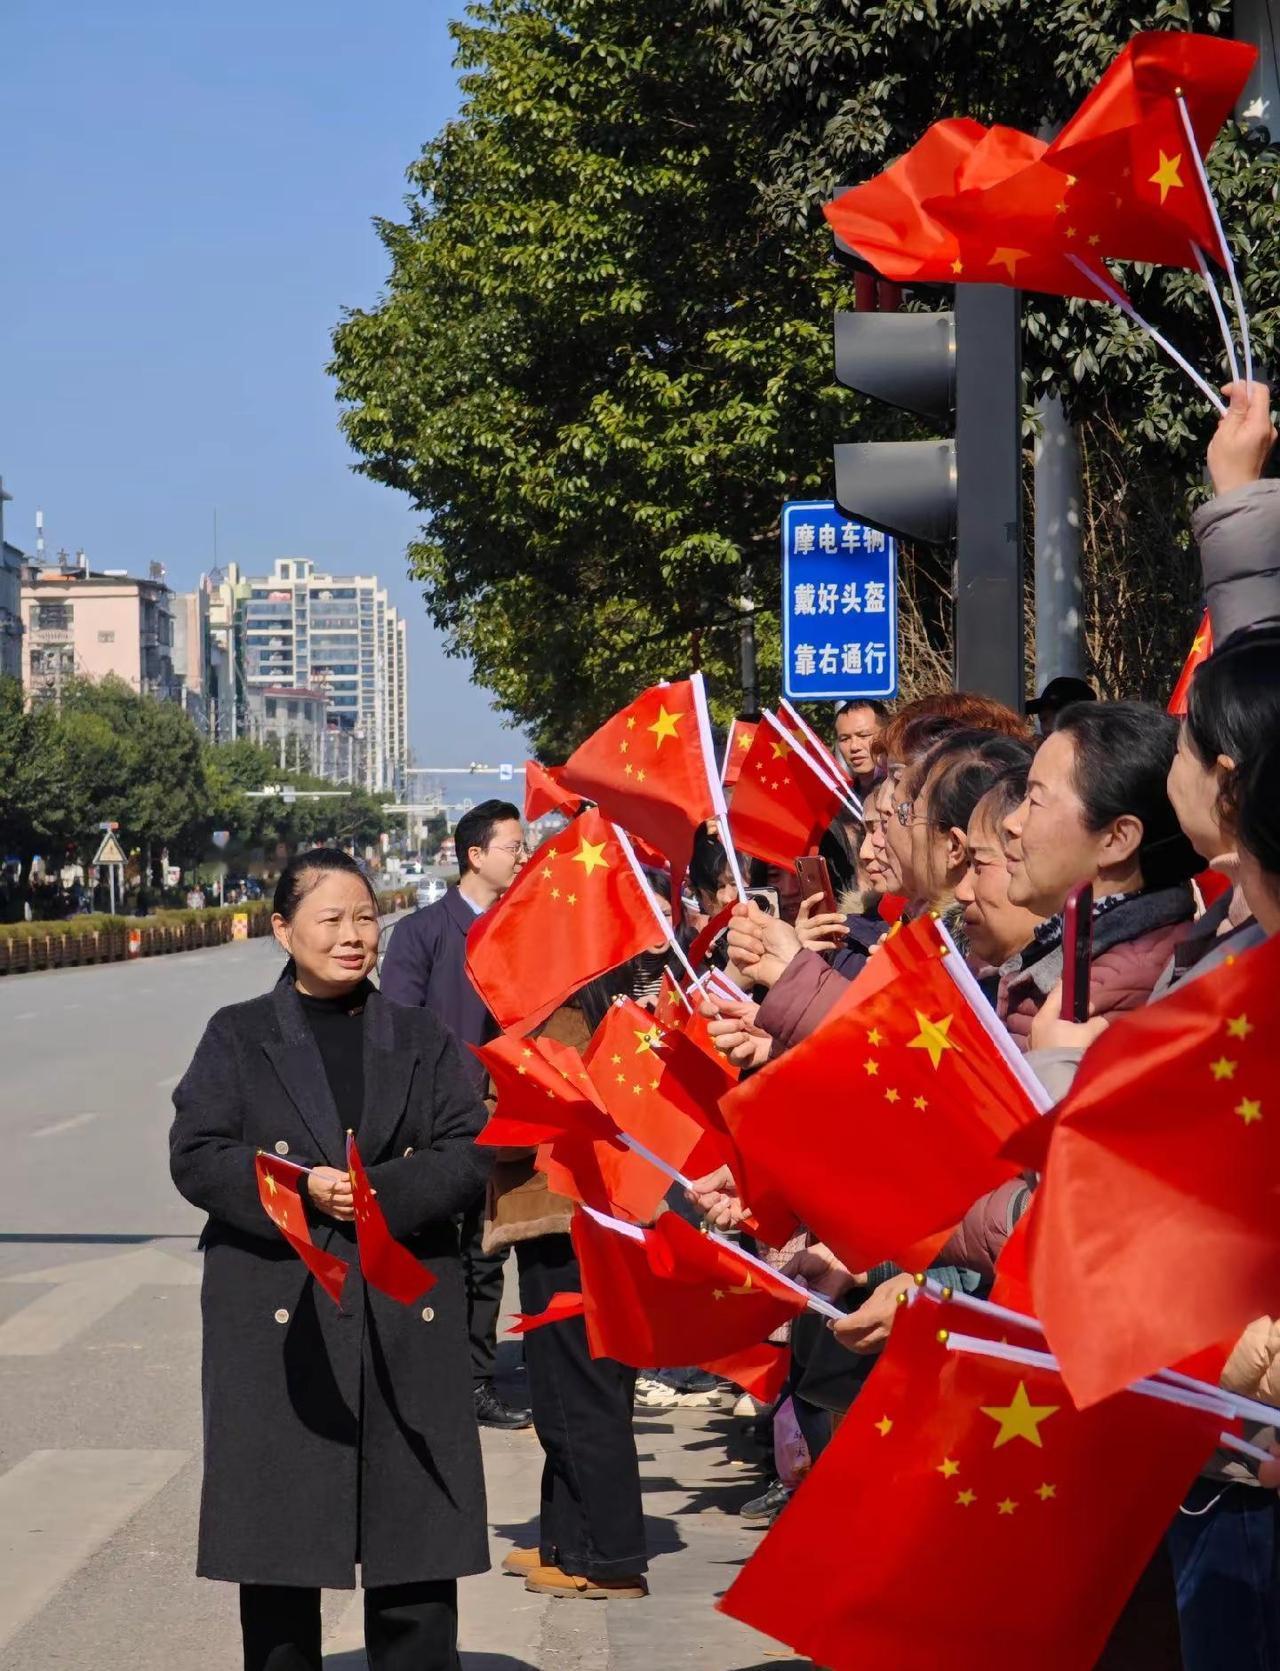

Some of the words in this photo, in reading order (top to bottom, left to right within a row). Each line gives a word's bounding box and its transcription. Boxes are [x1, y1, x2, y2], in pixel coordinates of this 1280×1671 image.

[794, 522, 885, 555] 摩电车辆
[794, 581, 886, 615] 戴好头盔
[794, 642, 886, 675] 靠右通行
